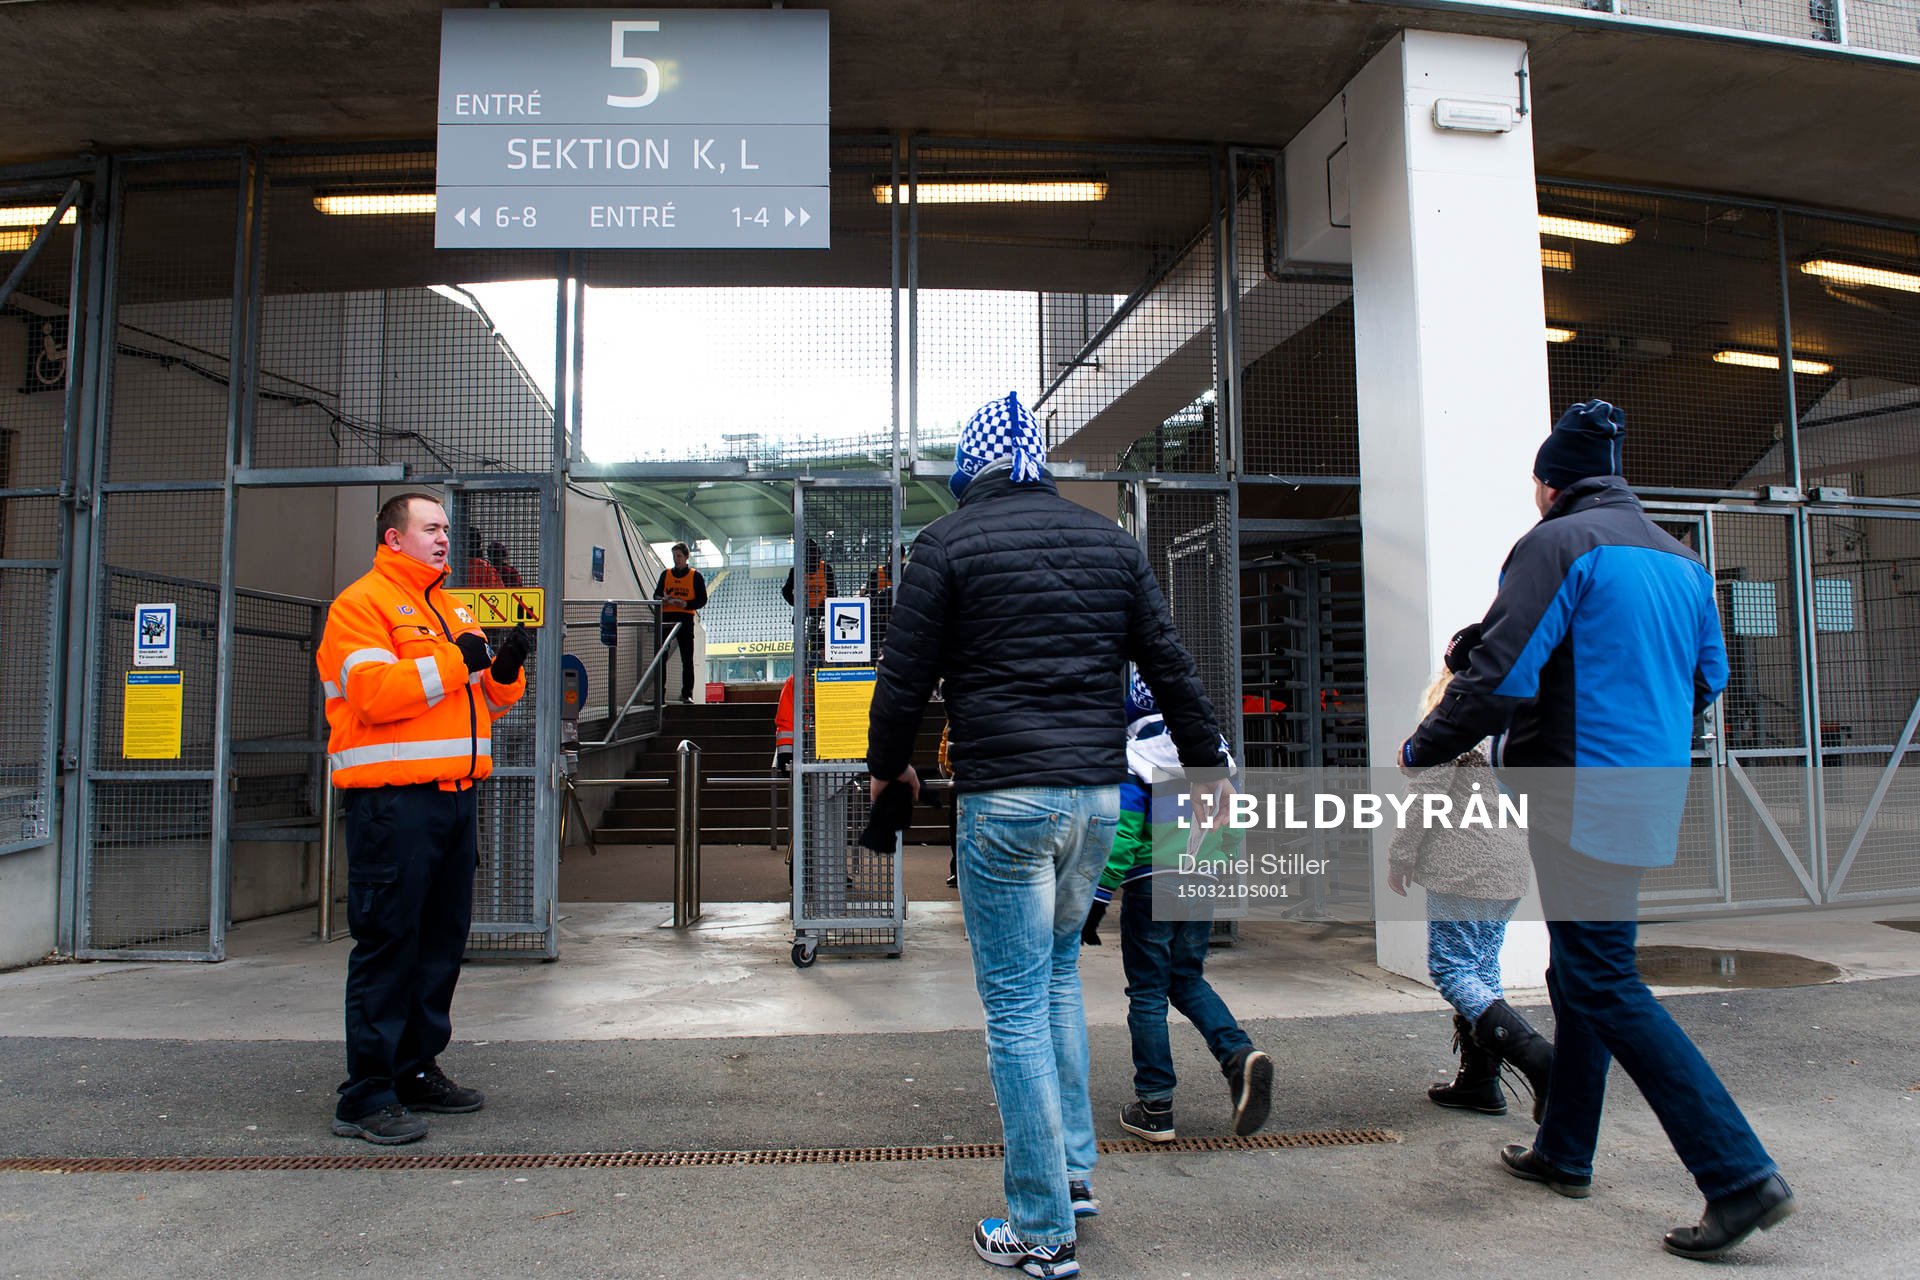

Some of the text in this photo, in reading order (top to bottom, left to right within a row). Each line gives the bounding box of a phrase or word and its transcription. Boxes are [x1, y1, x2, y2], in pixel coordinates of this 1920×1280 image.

[606, 21, 661, 108] 5
[455, 89, 542, 116] ENTRÉ
[507, 138, 759, 174] SEKTION K, L
[496, 202, 770, 228] 6-8 ENTRÉ 1-4
